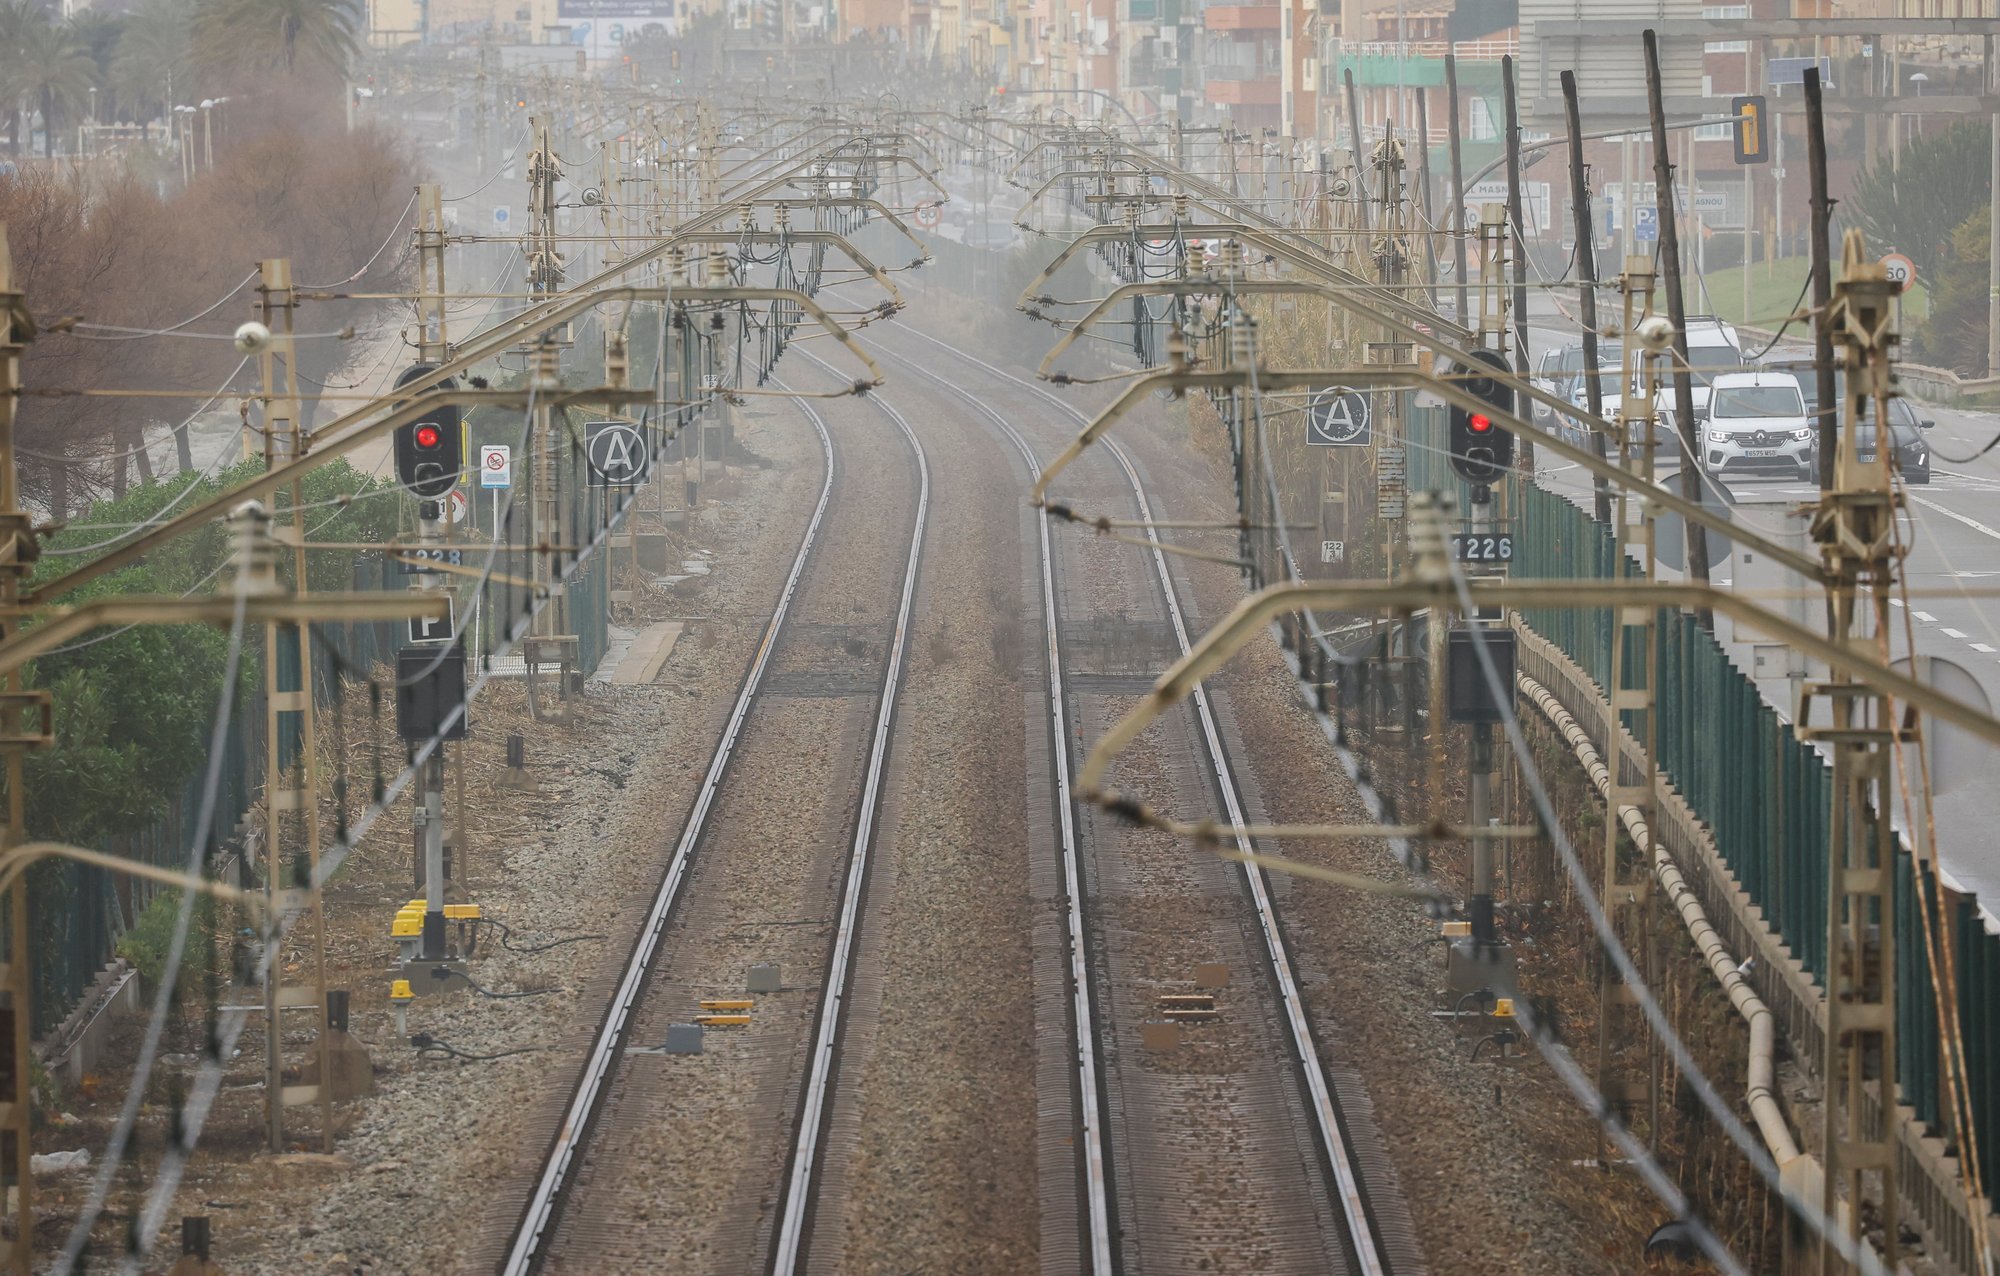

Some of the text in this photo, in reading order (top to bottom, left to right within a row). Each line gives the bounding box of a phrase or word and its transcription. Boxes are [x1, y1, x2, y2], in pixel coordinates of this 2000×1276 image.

[1324, 396, 1355, 431] A
[603, 432, 633, 470] A
[1324, 542, 1342, 550] 122
[1453, 538, 1512, 558] 1226
